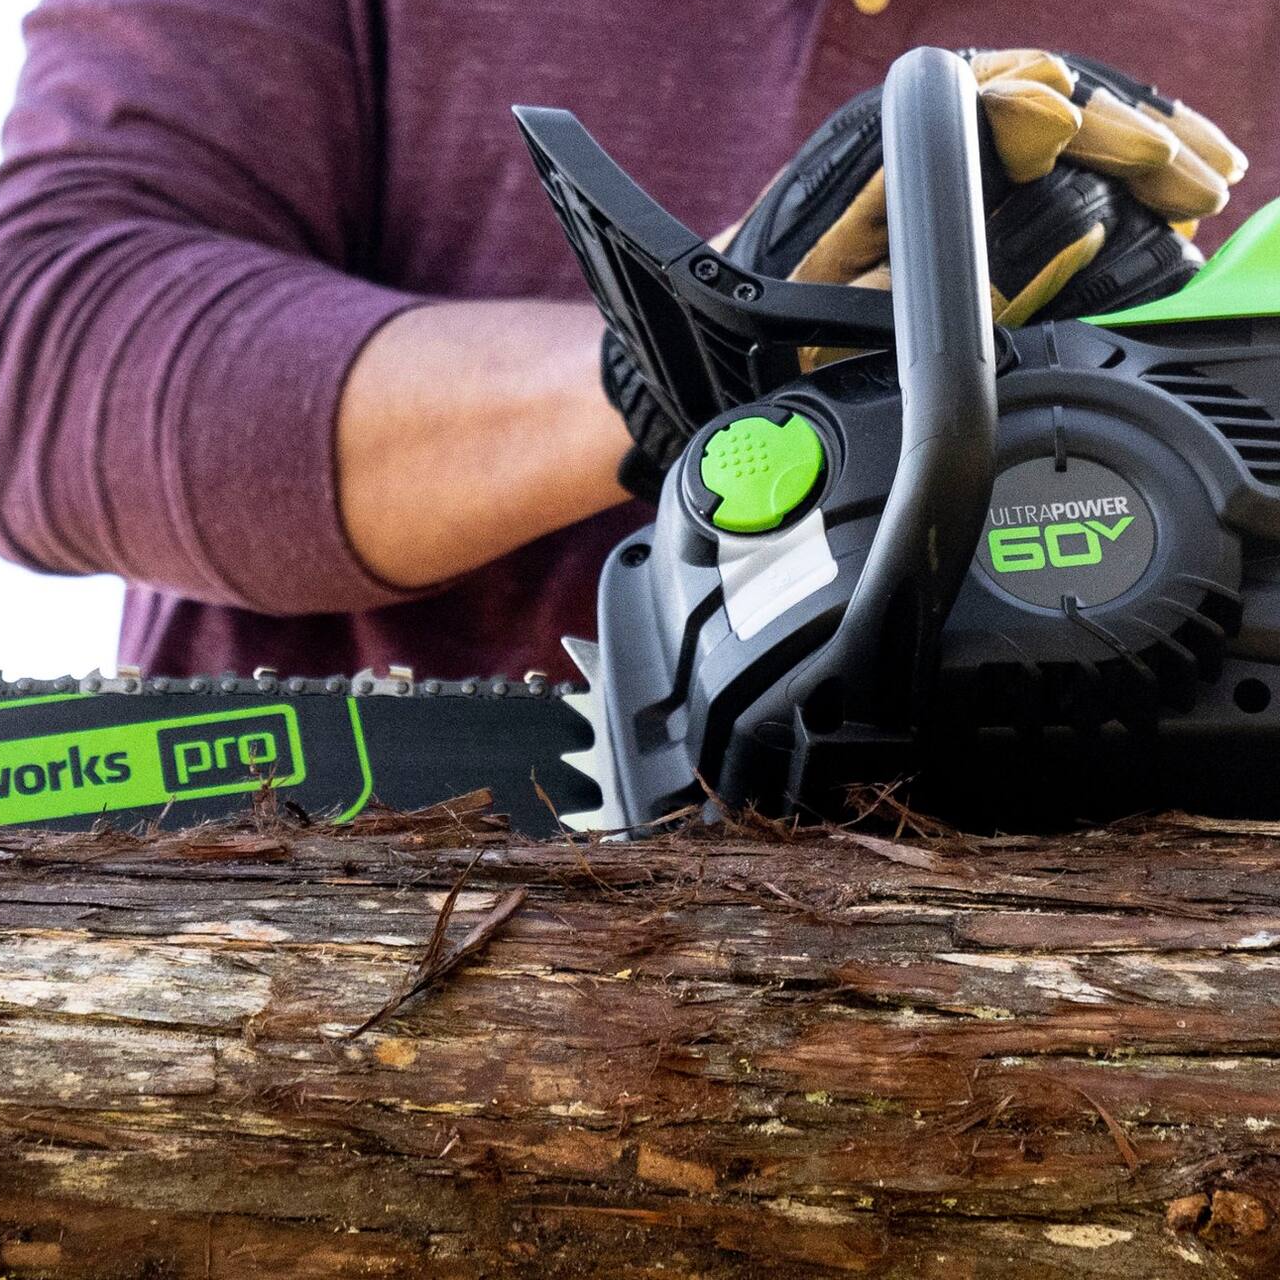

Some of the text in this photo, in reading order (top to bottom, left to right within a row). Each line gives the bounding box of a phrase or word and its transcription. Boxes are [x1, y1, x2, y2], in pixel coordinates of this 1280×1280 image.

[989, 496, 1130, 527] ULTRAPOWER
[987, 516, 1136, 574] 60V
[172, 730, 278, 782] pro
